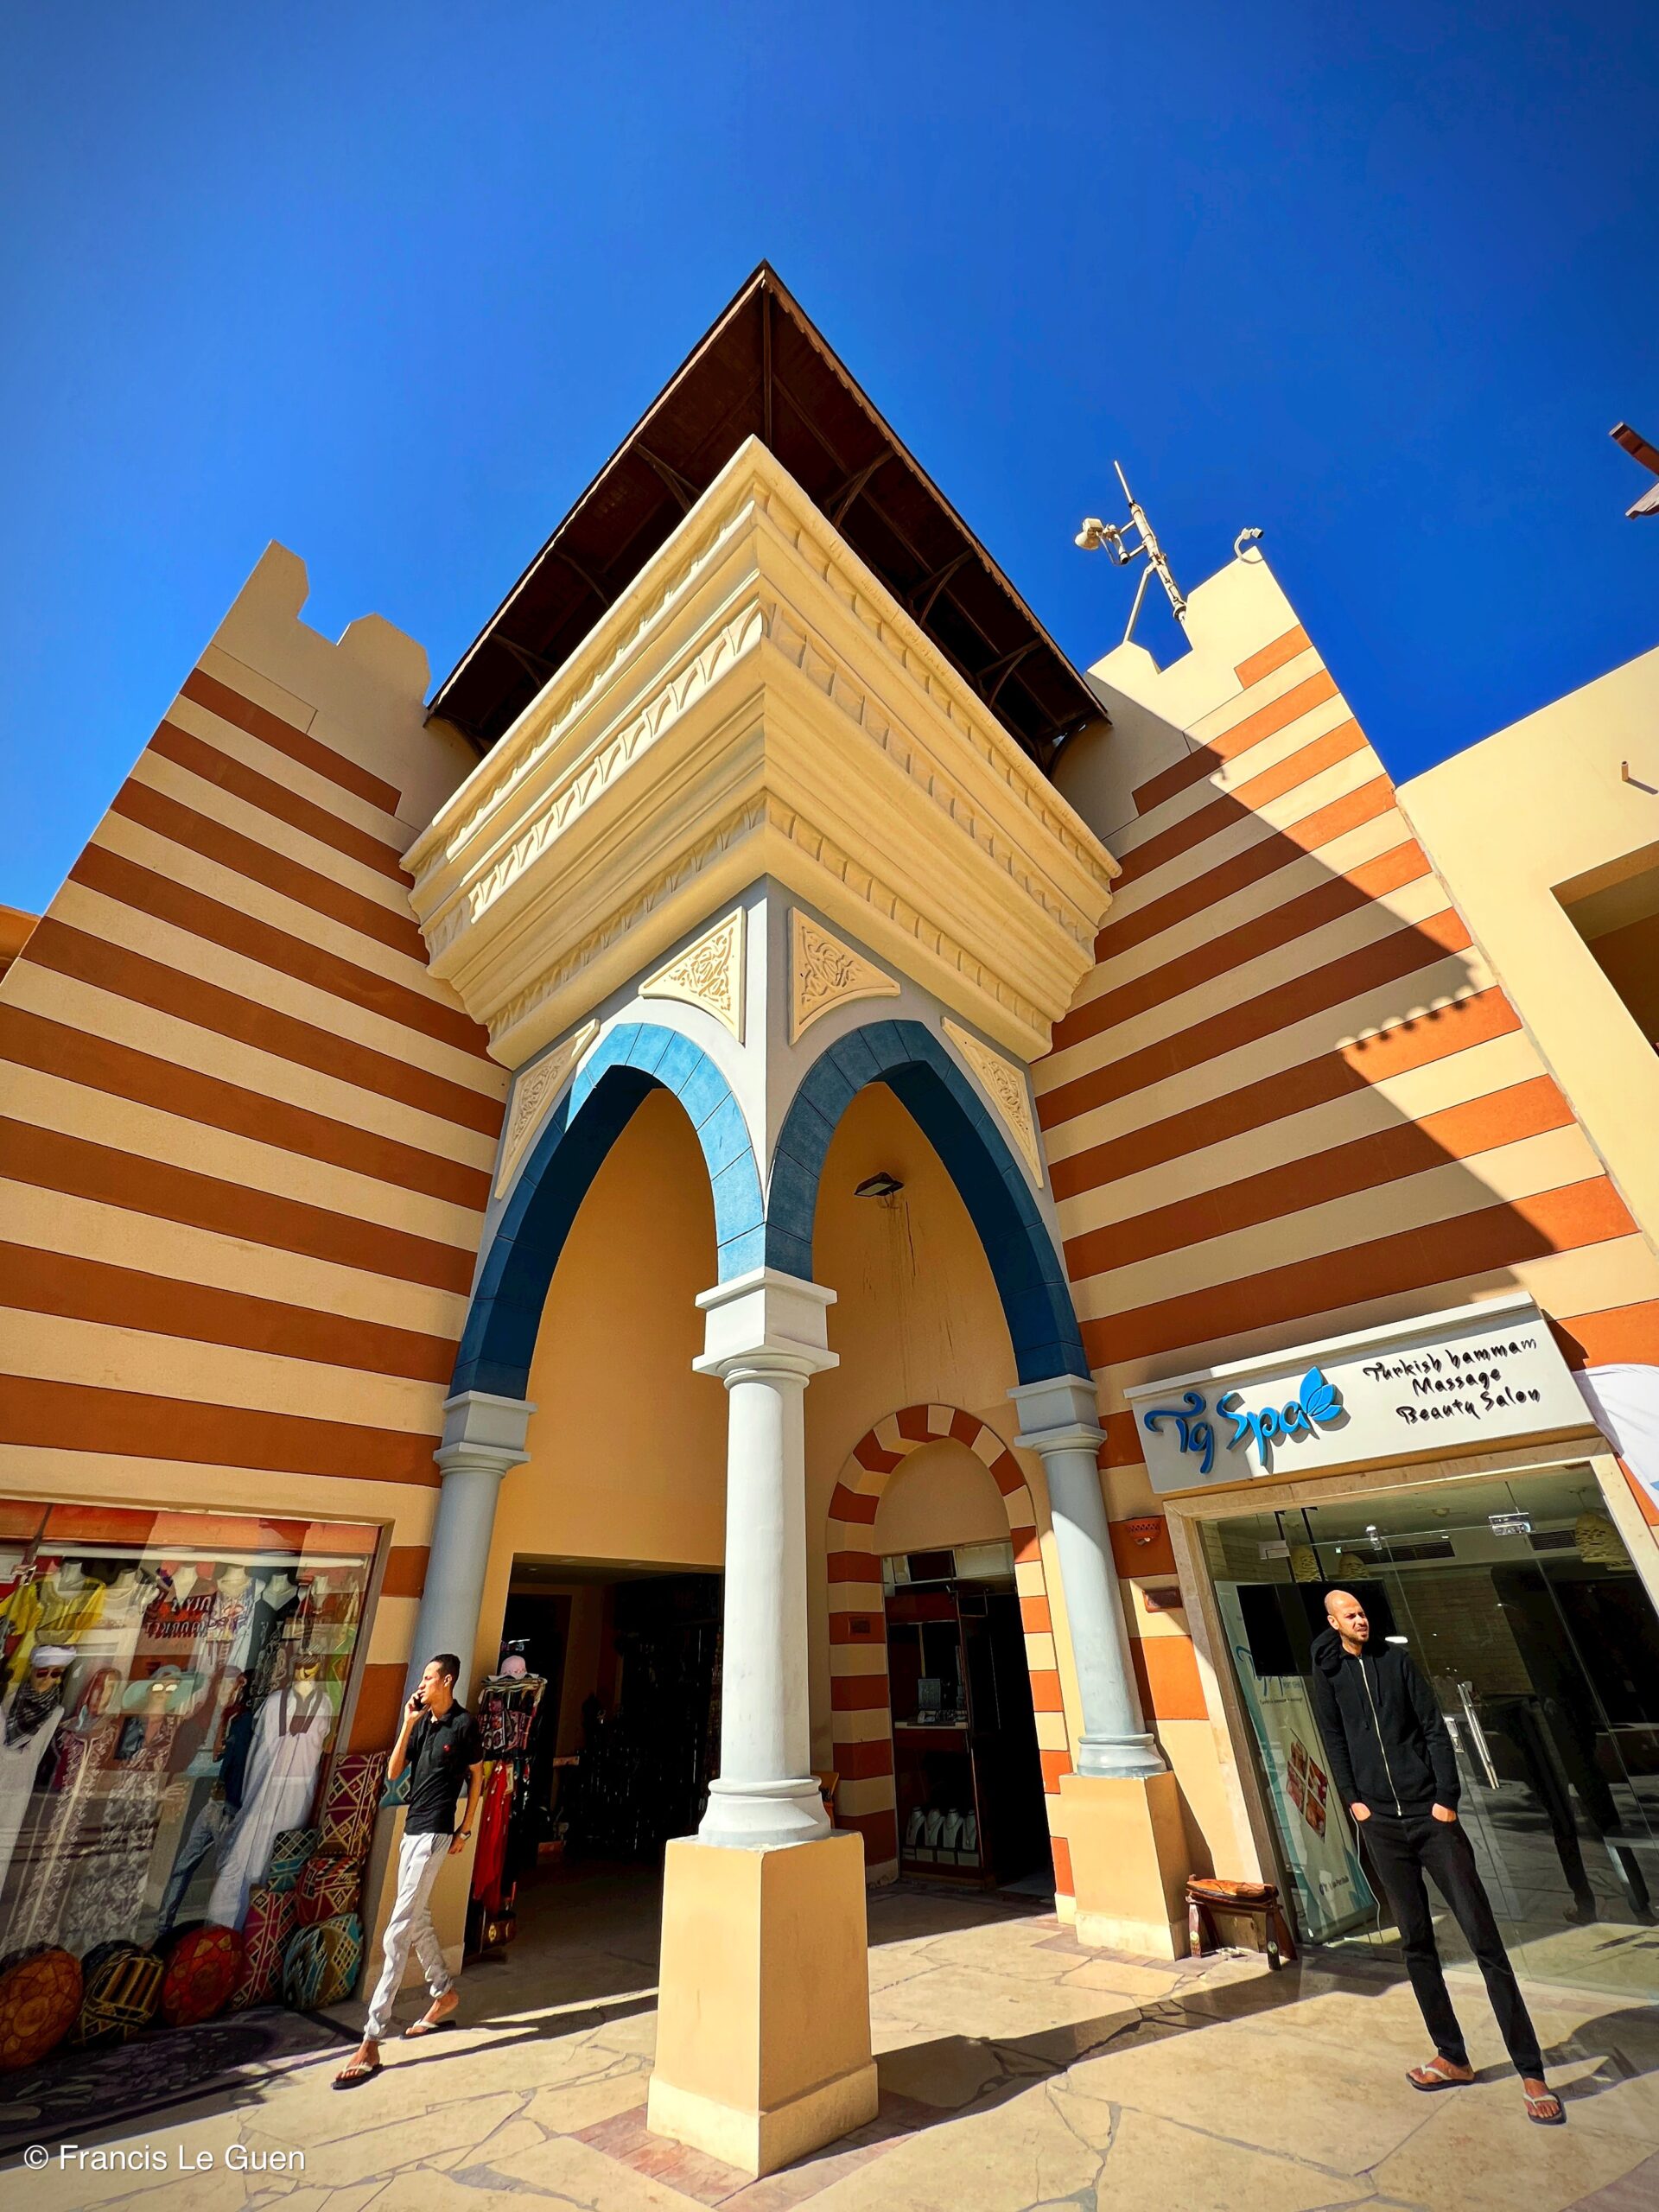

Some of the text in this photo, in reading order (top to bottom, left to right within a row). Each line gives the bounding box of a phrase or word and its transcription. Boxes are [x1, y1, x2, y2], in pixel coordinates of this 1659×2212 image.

[1412, 1369, 1502, 1397] Massage
[1395, 1386, 1541, 1426] Beauty Salon
[1216, 1391, 1311, 1466] Spa
